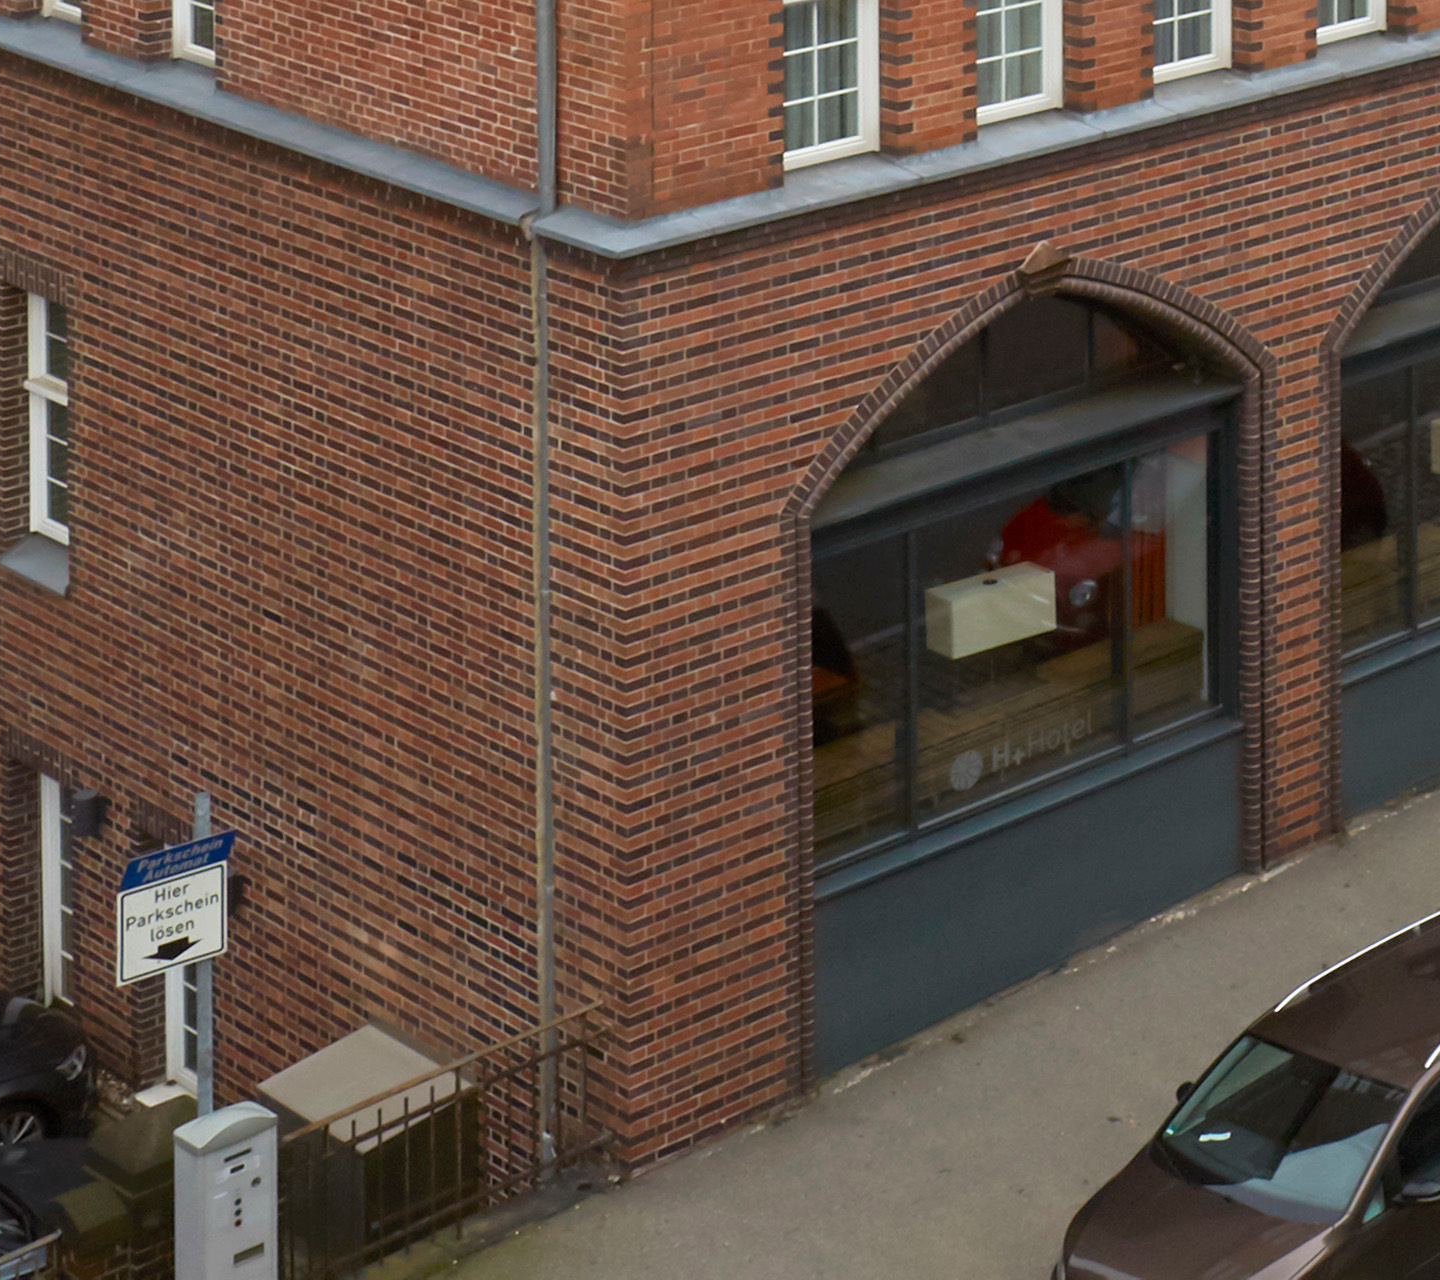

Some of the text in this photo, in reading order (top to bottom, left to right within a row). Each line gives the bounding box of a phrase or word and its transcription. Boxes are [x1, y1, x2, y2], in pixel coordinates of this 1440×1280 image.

[136, 839, 224, 873] Parkschein
[142, 852, 211, 883] Automat
[154, 882, 191, 904] Hier
[125, 892, 220, 932] Parkschein
[150, 919, 196, 943] lösen
